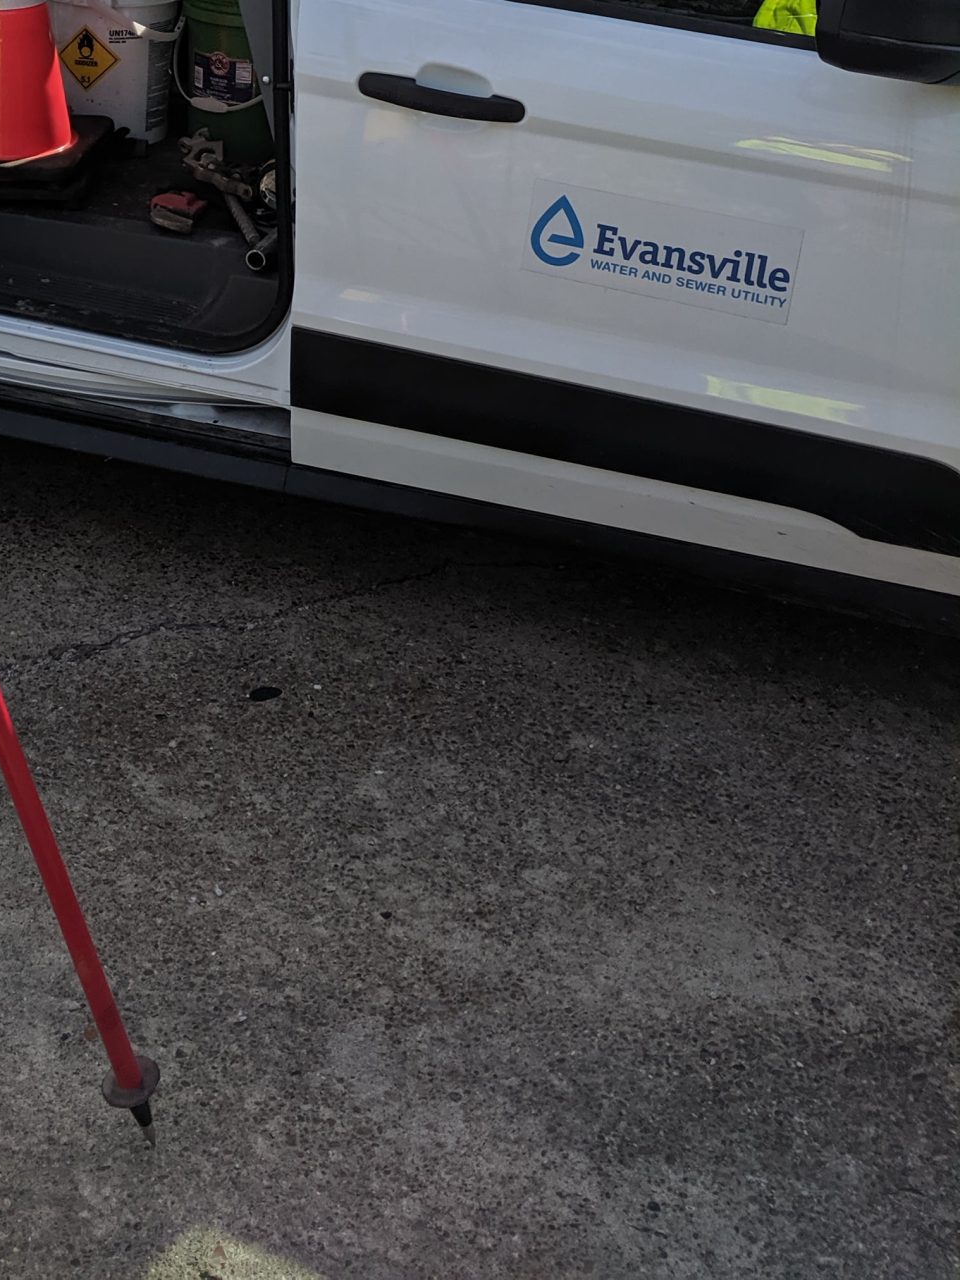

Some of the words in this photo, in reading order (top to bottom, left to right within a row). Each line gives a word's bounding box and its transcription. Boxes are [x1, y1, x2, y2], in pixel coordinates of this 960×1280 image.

[590, 259, 638, 279] WATER
[641, 270, 672, 285] AND
[675, 276, 727, 297] SEWER
[730, 287, 788, 309] UTILITY
[592, 223, 791, 292] Evansville
